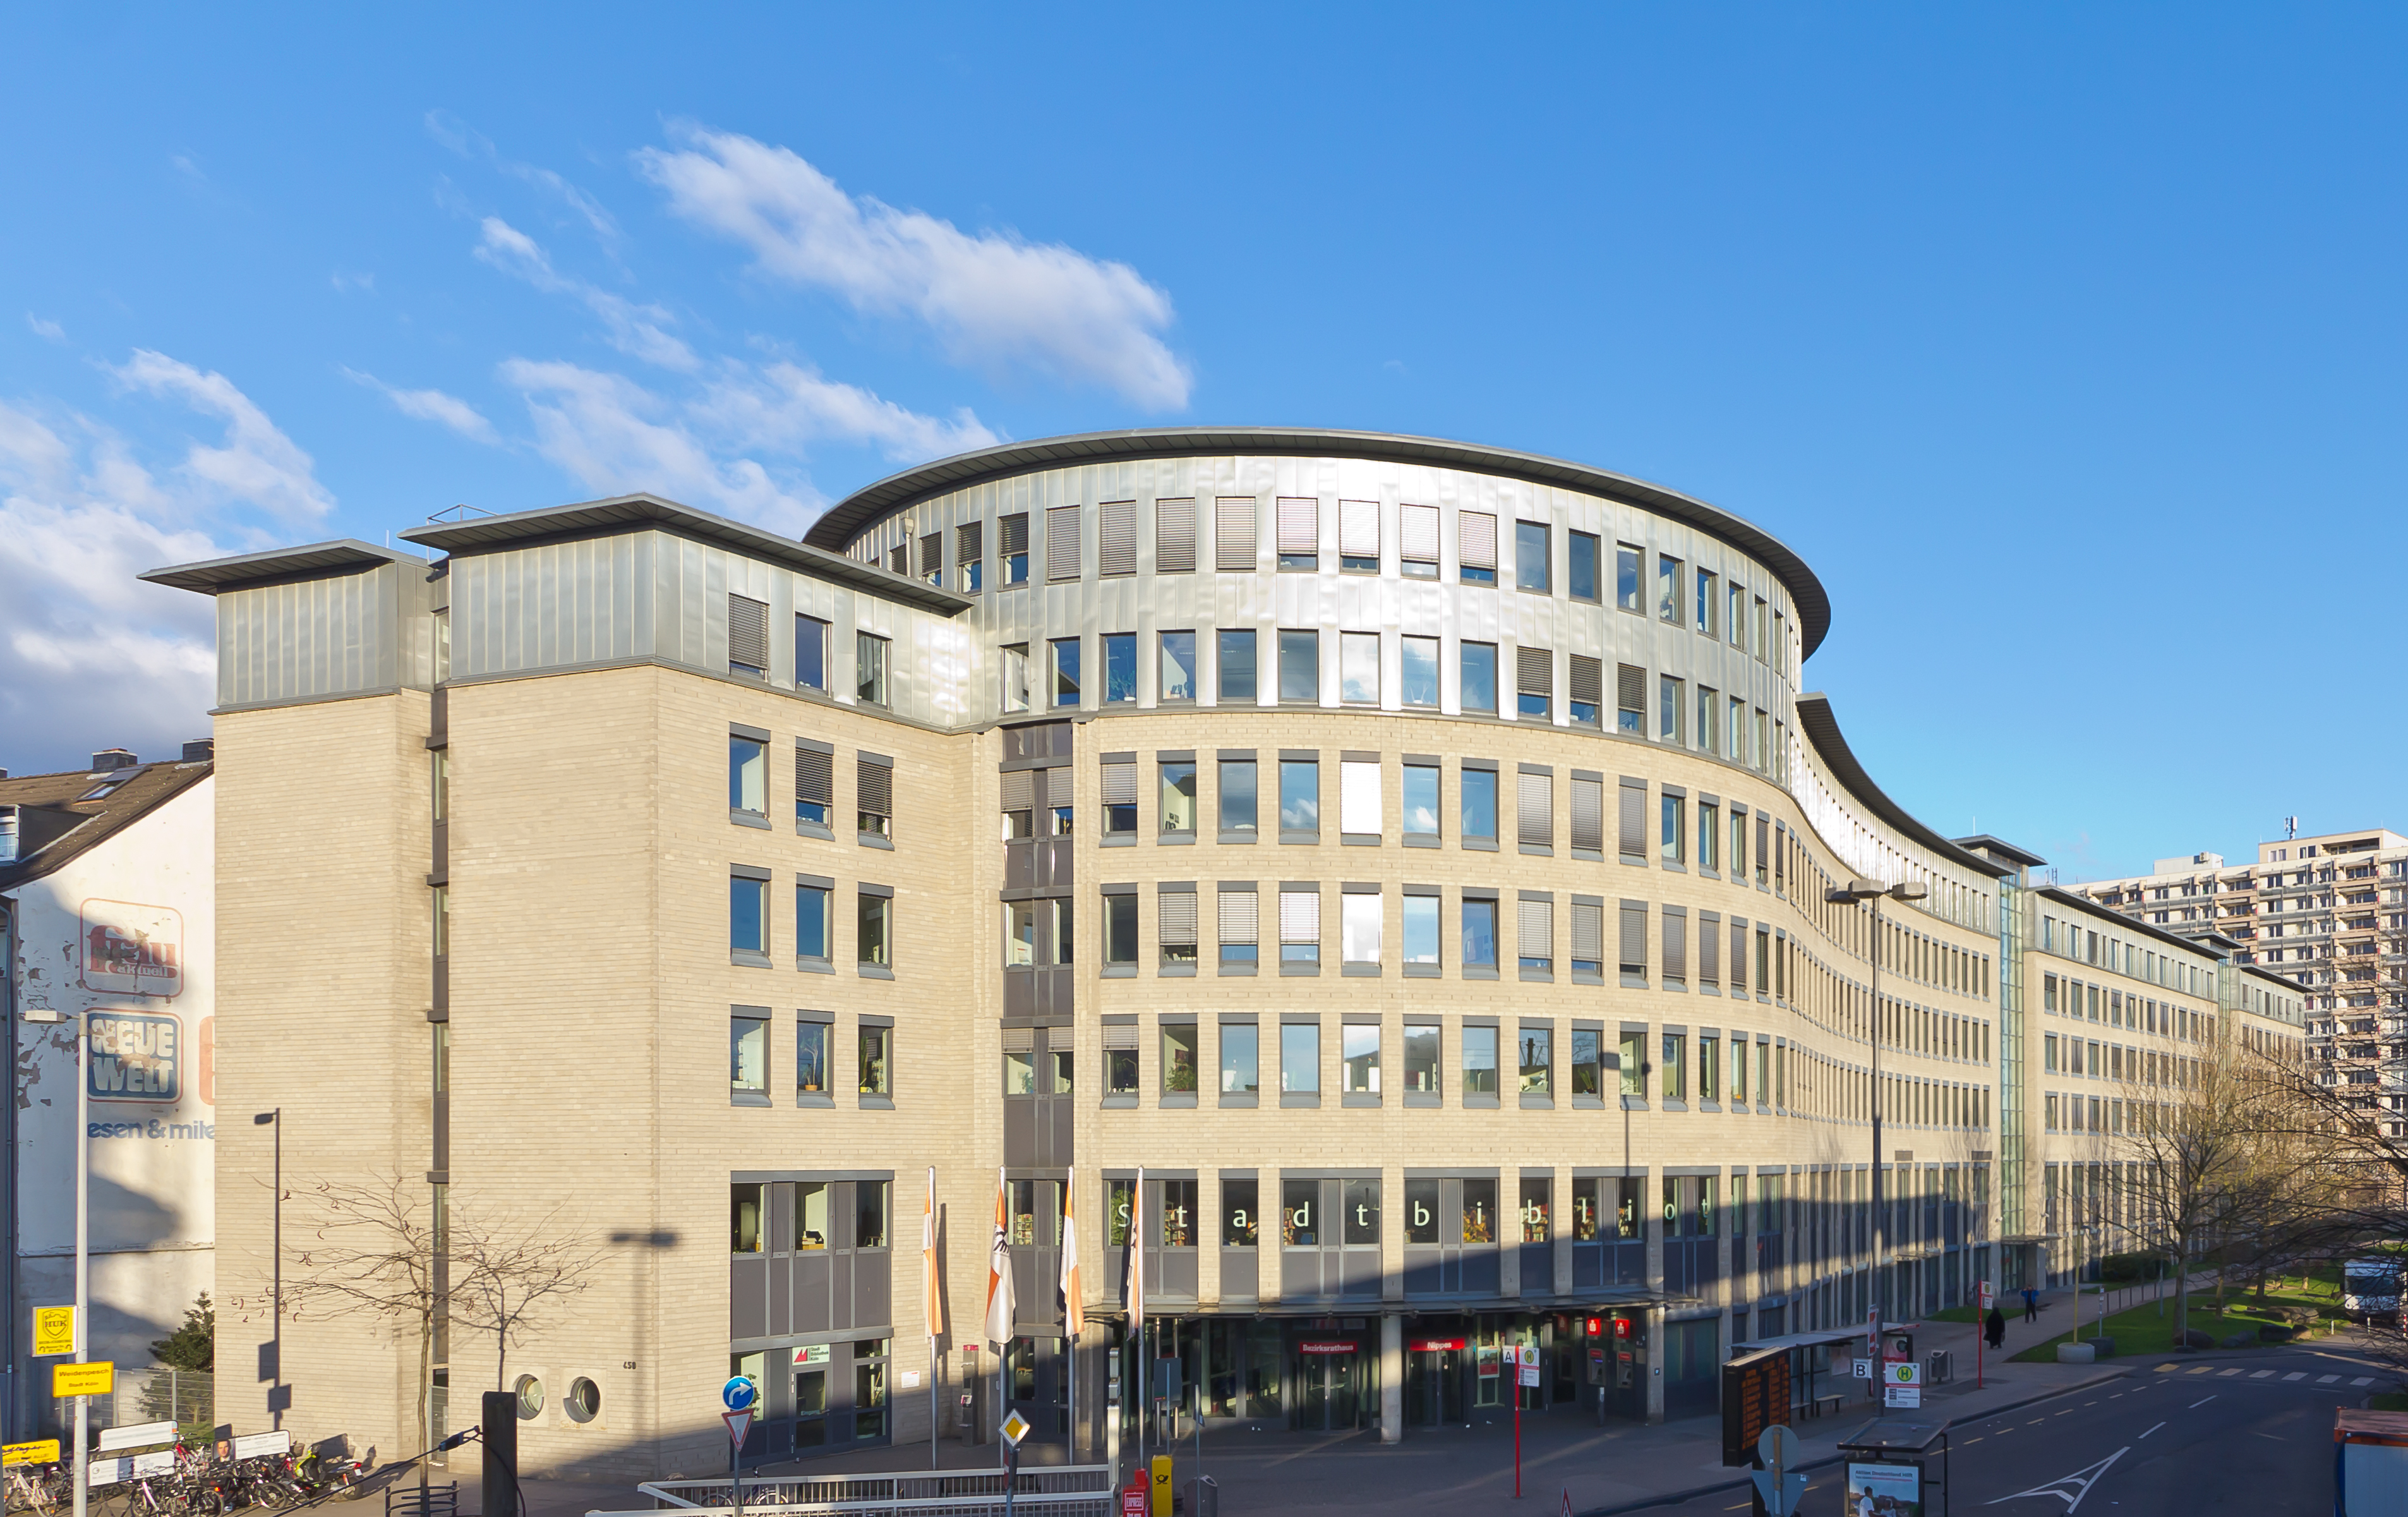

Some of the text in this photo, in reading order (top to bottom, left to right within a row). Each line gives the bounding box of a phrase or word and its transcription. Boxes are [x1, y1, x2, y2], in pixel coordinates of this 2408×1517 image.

[92, 1019, 174, 1057] NEUE
[93, 1057, 174, 1093] WELT
[87, 1122, 143, 1139] esen
[147, 1118, 166, 1139] &
[1303, 1344, 1354, 1352] Bezirksrathaus
[1427, 1341, 1452, 1350] Nippes
[1505, 1351, 1512, 1362] A
[59, 1369, 109, 1377] Weidenpesch
[1856, 1364, 1866, 1376] B
